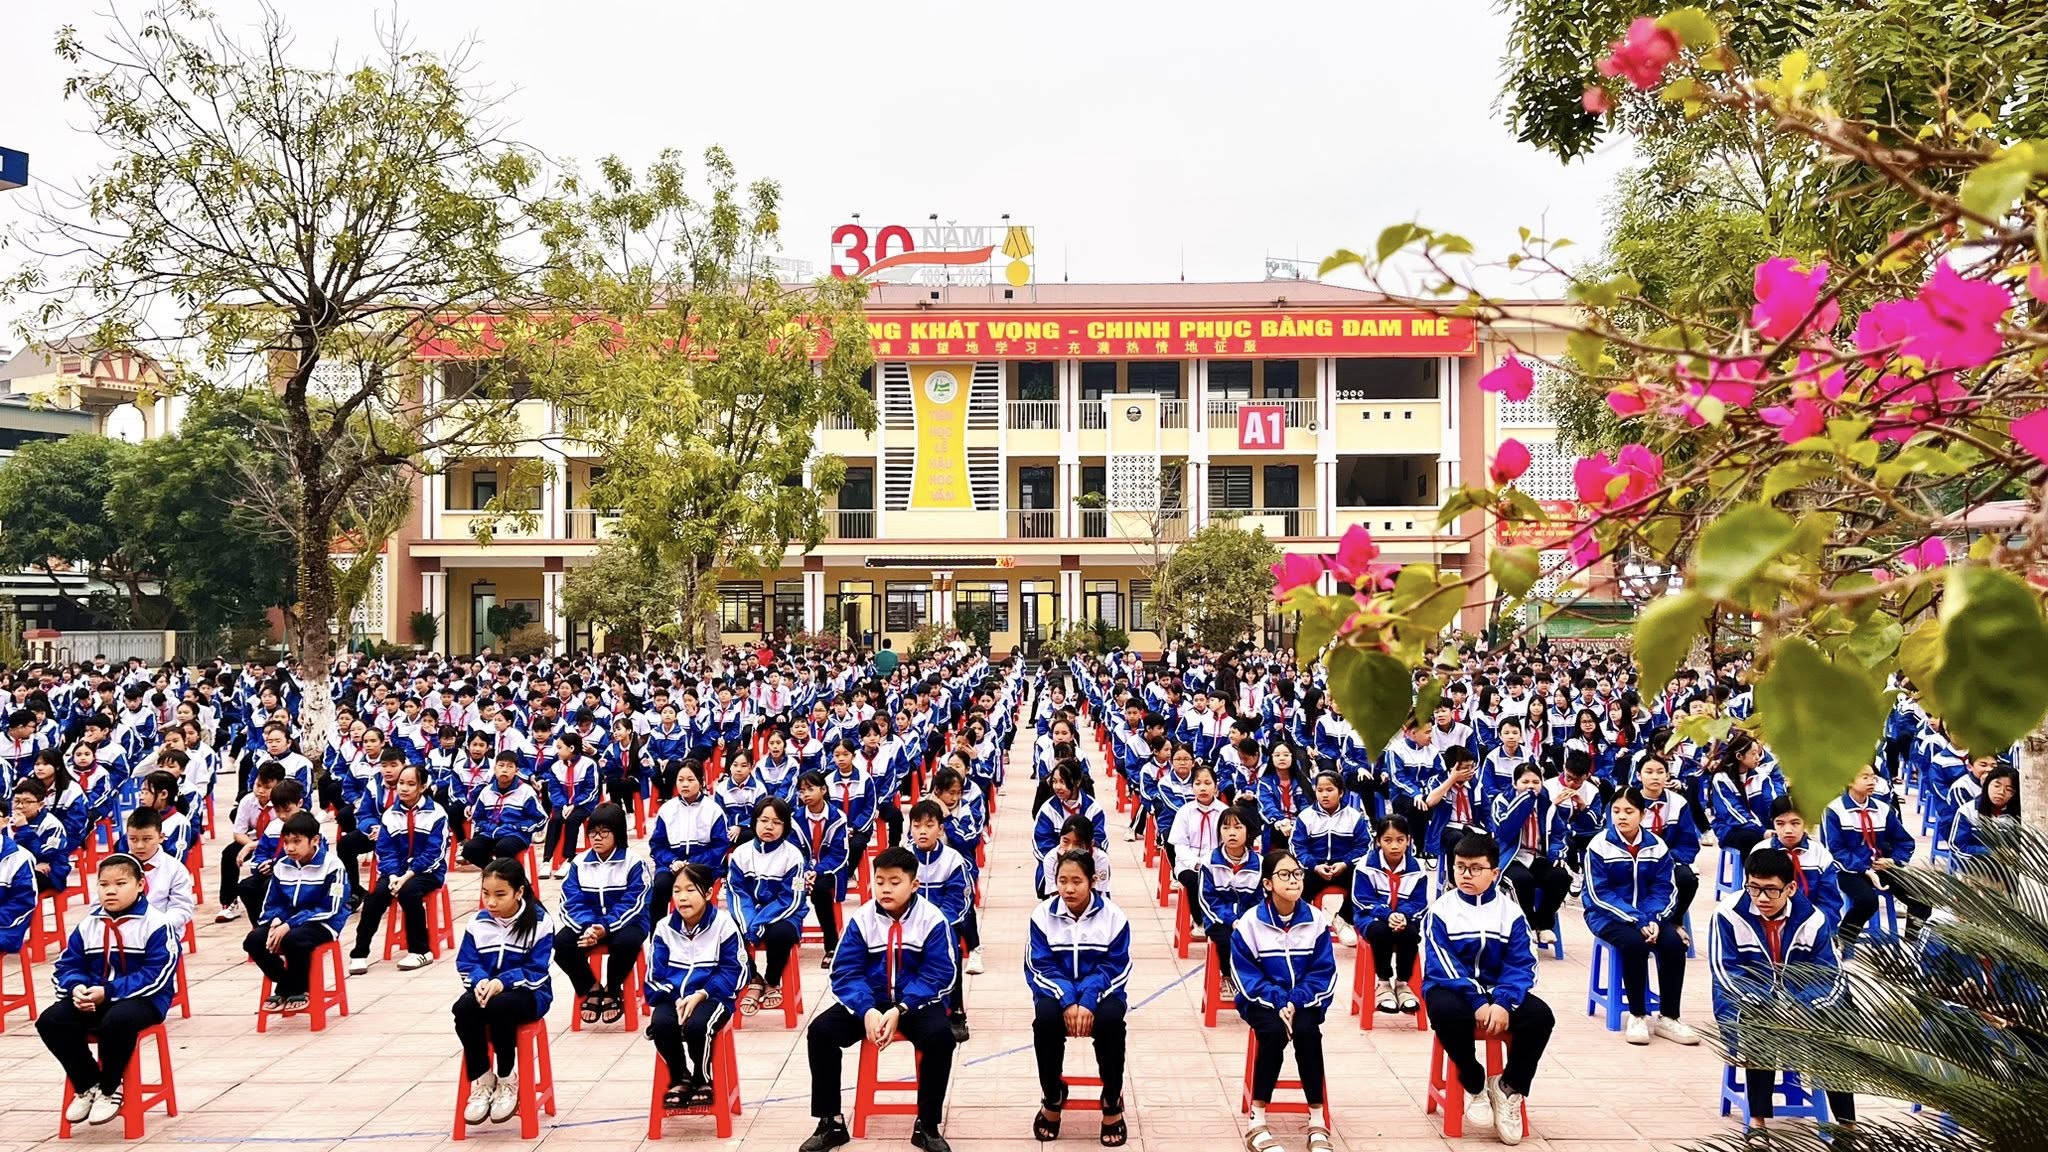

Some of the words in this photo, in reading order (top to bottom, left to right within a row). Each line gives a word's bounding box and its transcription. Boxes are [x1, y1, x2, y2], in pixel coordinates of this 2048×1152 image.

[831, 224, 915, 281] 30
[922, 220, 984, 248] NĂM
[911, 319, 980, 339] KHÁT
[987, 321, 1060, 342] VỌNG
[1087, 321, 1170, 339] CHINH
[1179, 319, 1251, 341] PHỤC
[1261, 315, 1333, 337] BẰNG
[1341, 319, 1402, 337] ĐAM
[1411, 316, 1450, 336] MÊ
[1243, 411, 1280, 444] A1
